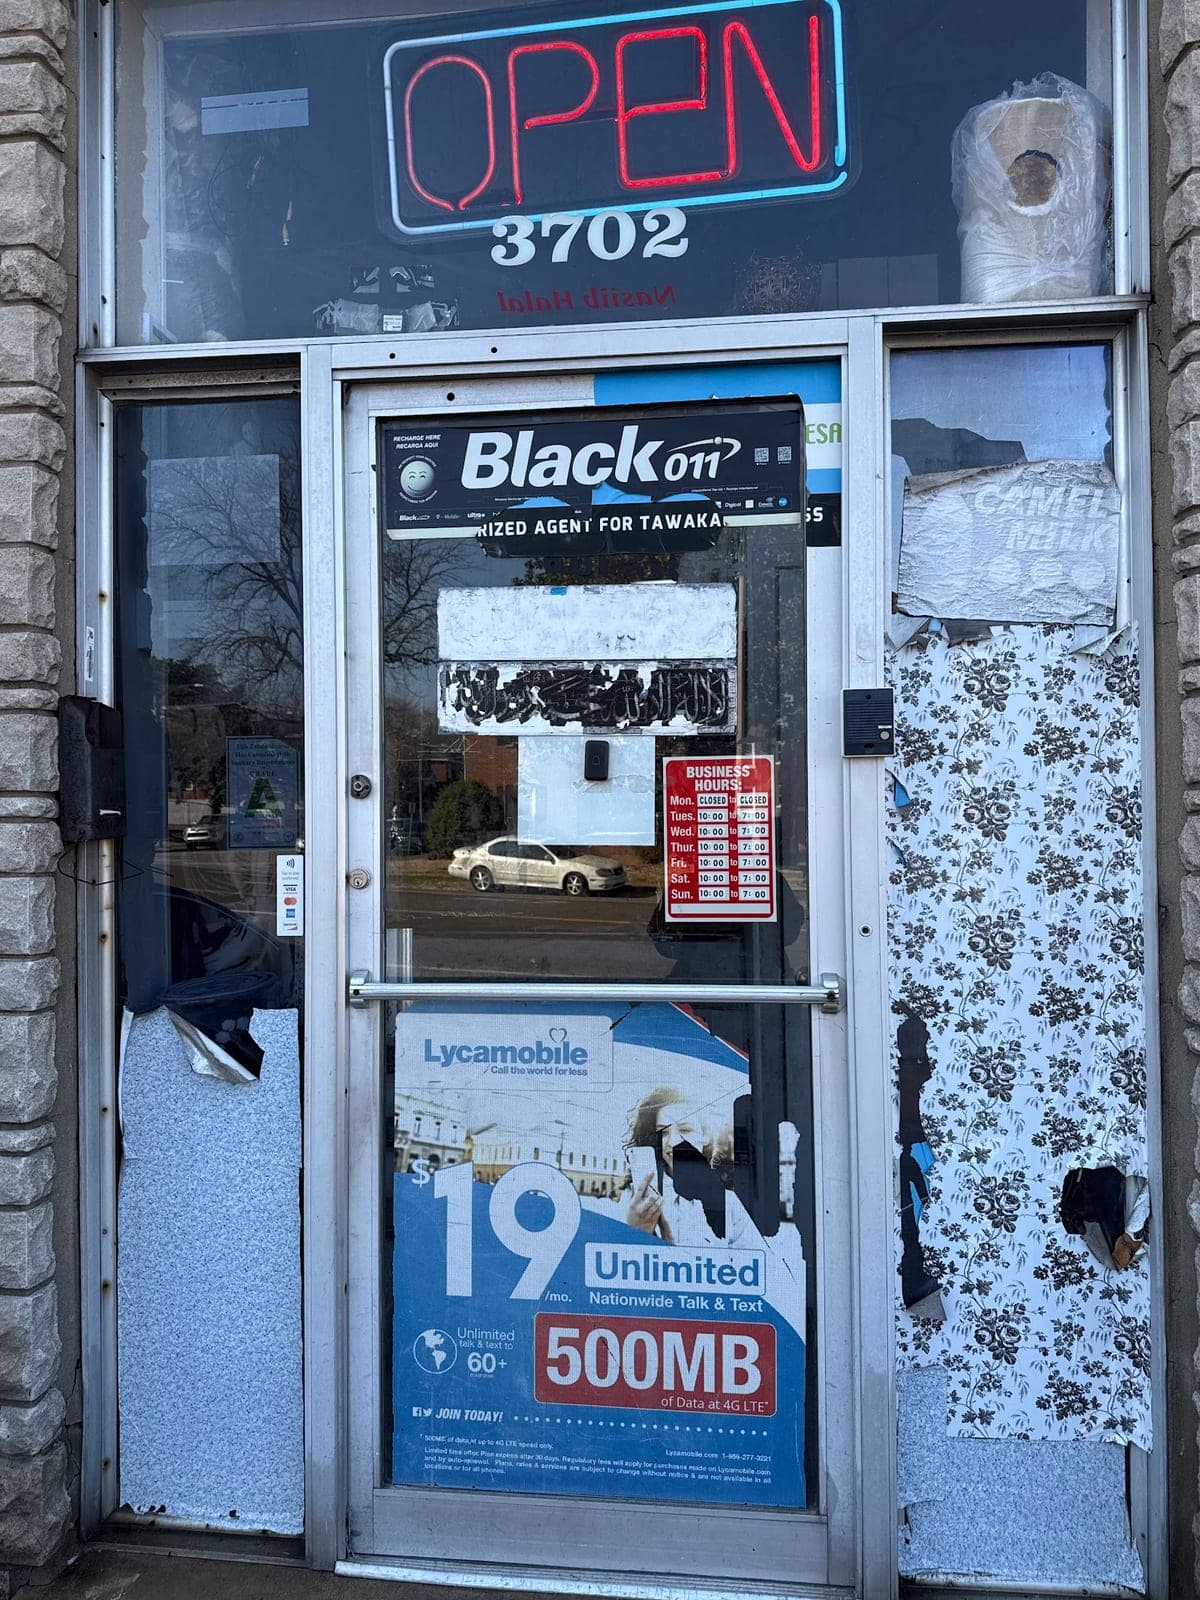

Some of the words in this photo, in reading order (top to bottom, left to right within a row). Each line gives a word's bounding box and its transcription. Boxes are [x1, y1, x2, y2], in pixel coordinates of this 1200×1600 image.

[404, 15, 820, 211] OPEN
[491, 207, 689, 266] 3702
[461, 424, 665, 490] Black
[664, 451, 721, 482] 011
[534, 518, 593, 535] AGENT
[599, 516, 633, 532] FOR
[640, 511, 729, 530] TAWAKA
[686, 766, 750, 778] BUSINESS
[695, 779, 742, 791] HOURS:
[245, 777, 283, 818] A
[670, 796, 695, 806] Mon.
[699, 796, 726, 804] CLOSED
[729, 796, 737, 804] to
[740, 796, 767, 804] CLOSED
[670, 812, 696, 821] Tues.
[670, 826, 694, 836] Wed.
[700, 828, 724, 836] 10:00
[670, 842, 696, 852] Thur.
[730, 842, 738, 850] to
[671, 858, 686, 868] Fri.
[730, 858, 738, 866] to
[671, 874, 690, 883] Sat.
[730, 874, 738, 882] to
[671, 890, 694, 899] Sun.
[730, 890, 738, 898] to
[424, 1039, 588, 1067] Lycamobile
[490, 1066, 508, 1074] Call
[510, 1066, 526, 1074] the
[526, 1066, 553, 1075] world
[554, 1066, 568, 1075] for
[568, 1067, 588, 1076] less
[594, 1250, 760, 1287] Unlimited
[544, 1290, 572, 1302] /mo.
[589, 1291, 673, 1308] Nationwide
[677, 1294, 709, 1310] Talk
[714, 1298, 726, 1311] &
[730, 1298, 763, 1313] Text
[457, 1327, 515, 1341] Unlimited
[460, 1340, 475, 1348] talk
[467, 1352, 508, 1374] 60+
[545, 1326, 762, 1396] 500MB
[660, 1395, 674, 1407] of
[676, 1396, 705, 1409] Data
[707, 1399, 720, 1410] at
[723, 1399, 740, 1411] 4G
[435, 1408, 462, 1420] JOIN
[464, 1410, 504, 1423] TODAY!
[438, 1456, 446, 1464] by
